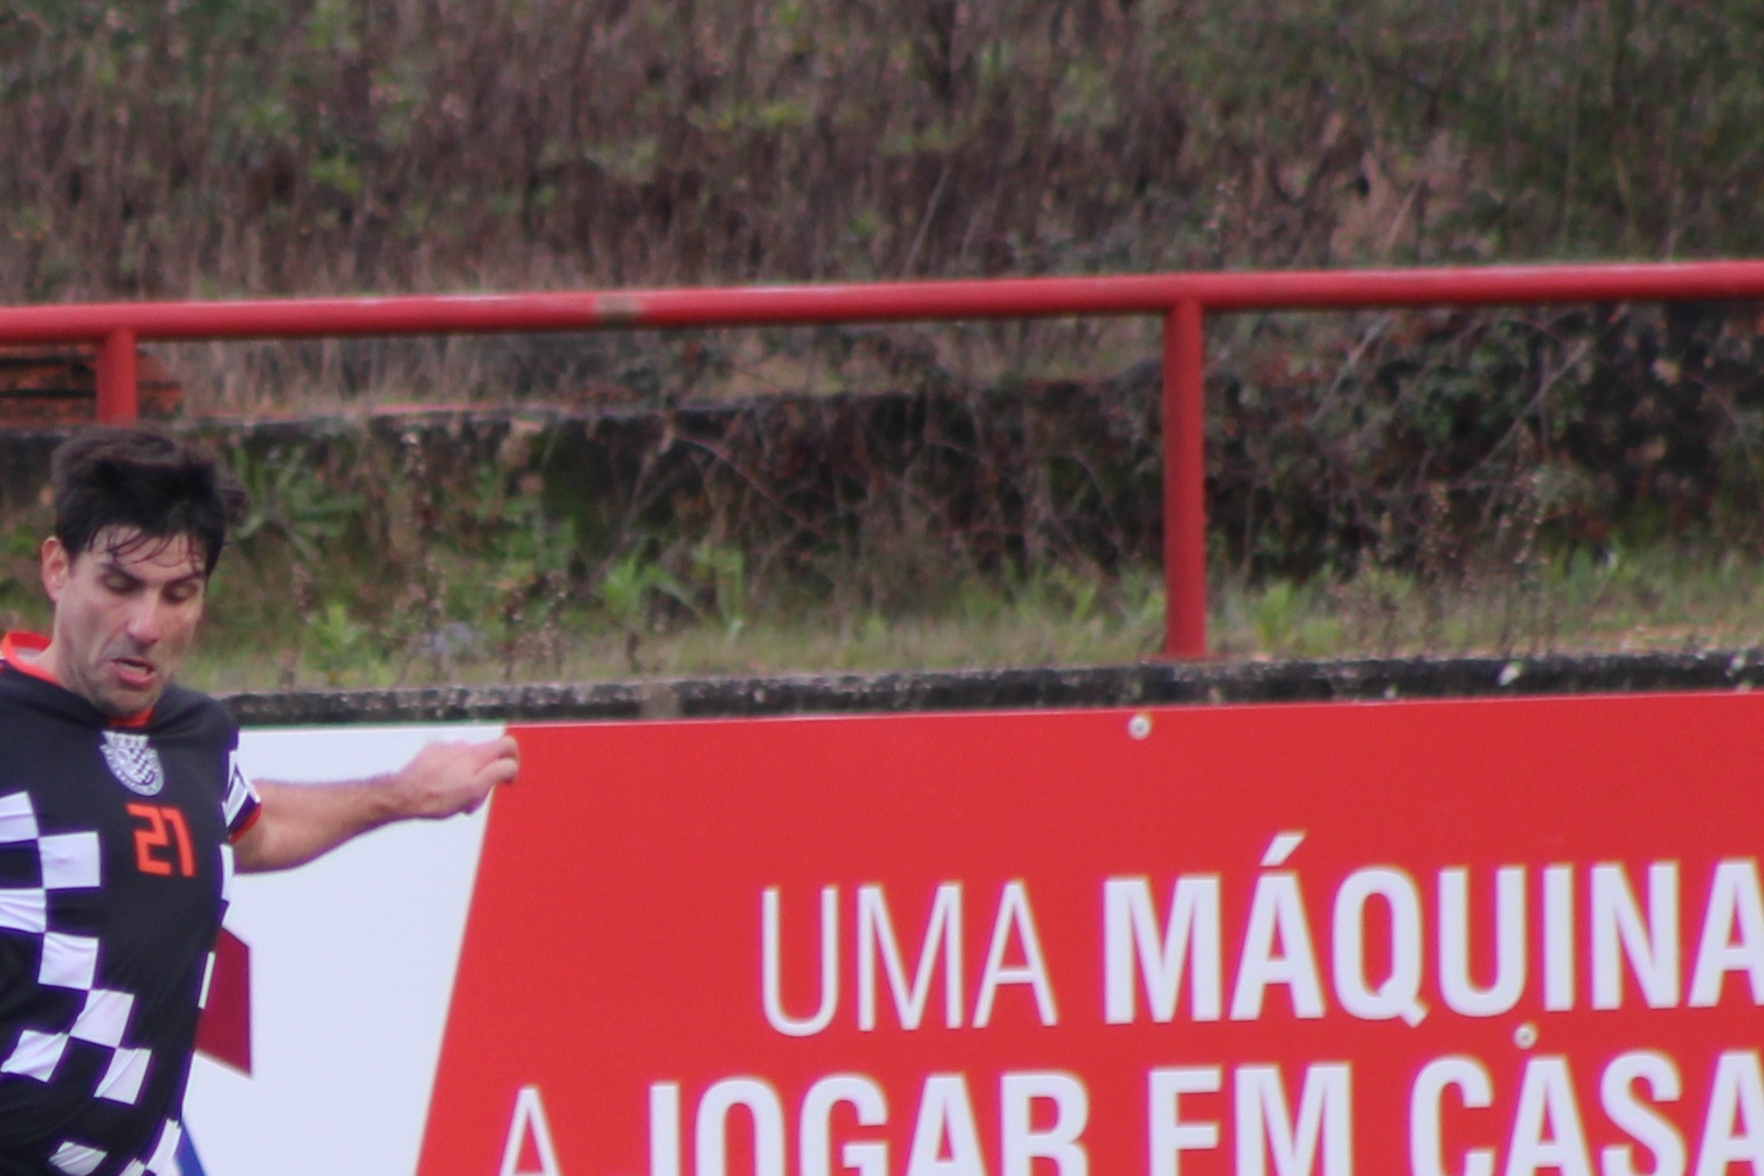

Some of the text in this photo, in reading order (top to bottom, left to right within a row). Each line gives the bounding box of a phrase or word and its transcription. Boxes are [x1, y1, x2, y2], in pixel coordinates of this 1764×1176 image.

[126, 802, 196, 877] 21
[762, 830, 1764, 1037] UMA MÁQUINA
